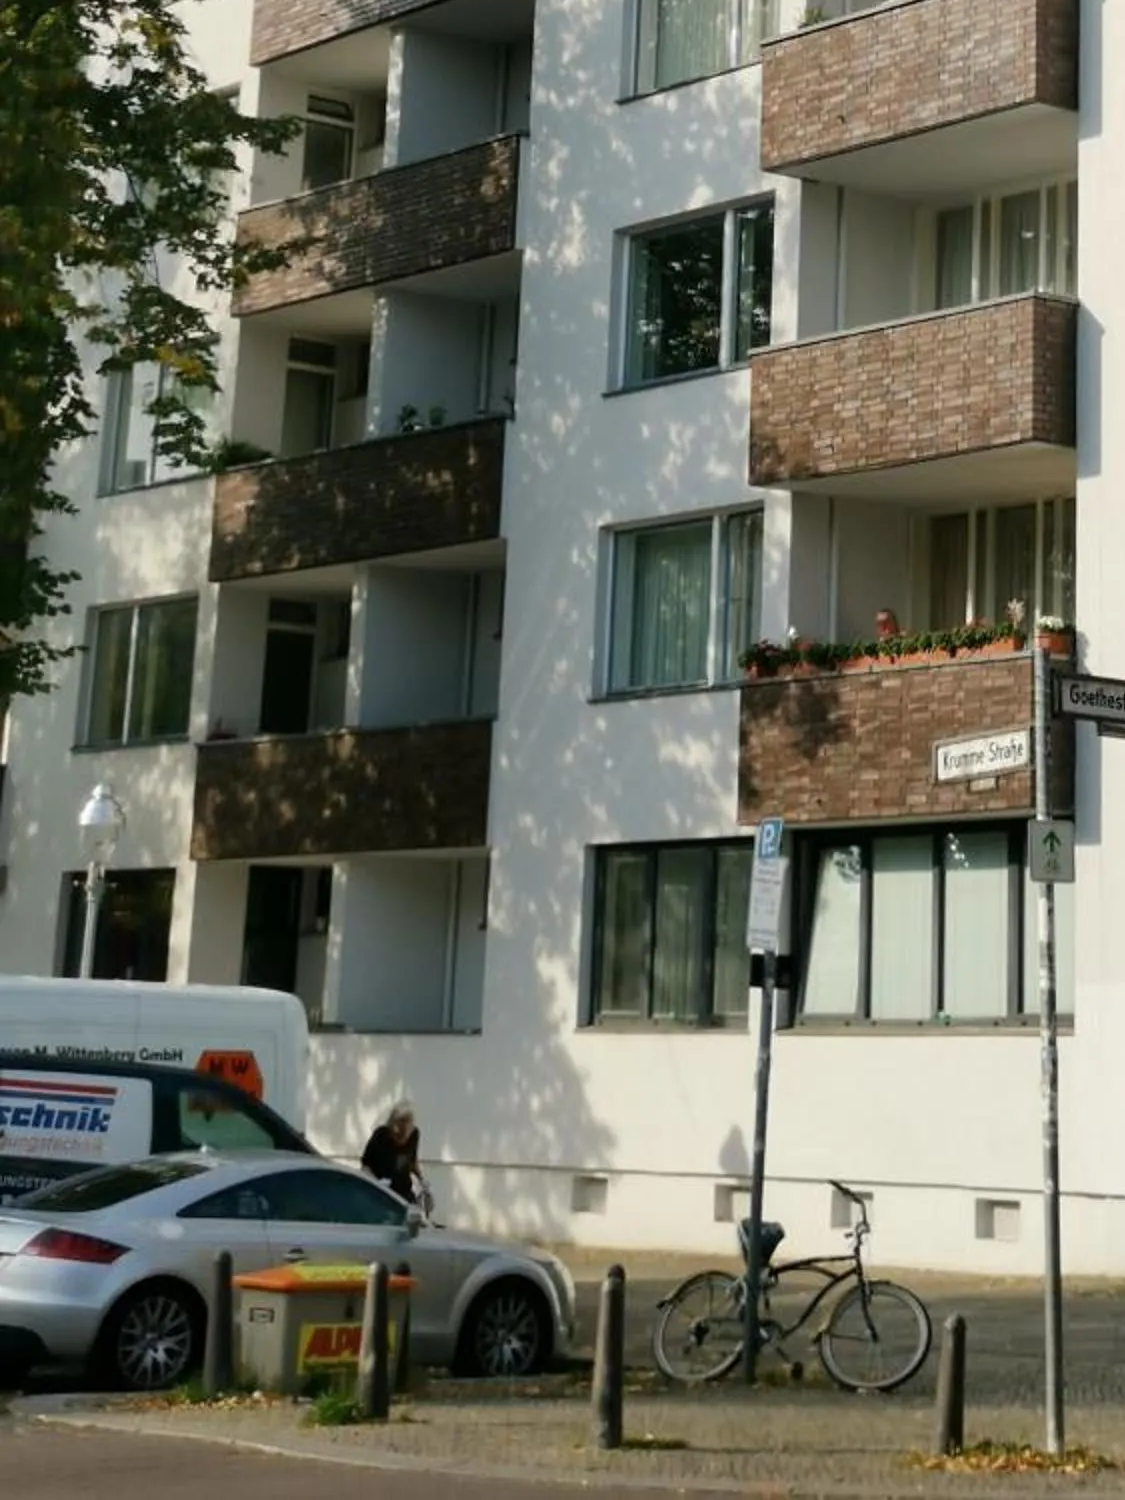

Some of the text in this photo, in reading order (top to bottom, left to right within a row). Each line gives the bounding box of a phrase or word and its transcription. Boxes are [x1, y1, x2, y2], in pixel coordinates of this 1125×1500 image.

[943, 750, 985, 770] Krumme
[56, 1046, 135, 1063] Wittenberg
[139, 1047, 183, 1062] GmbH
